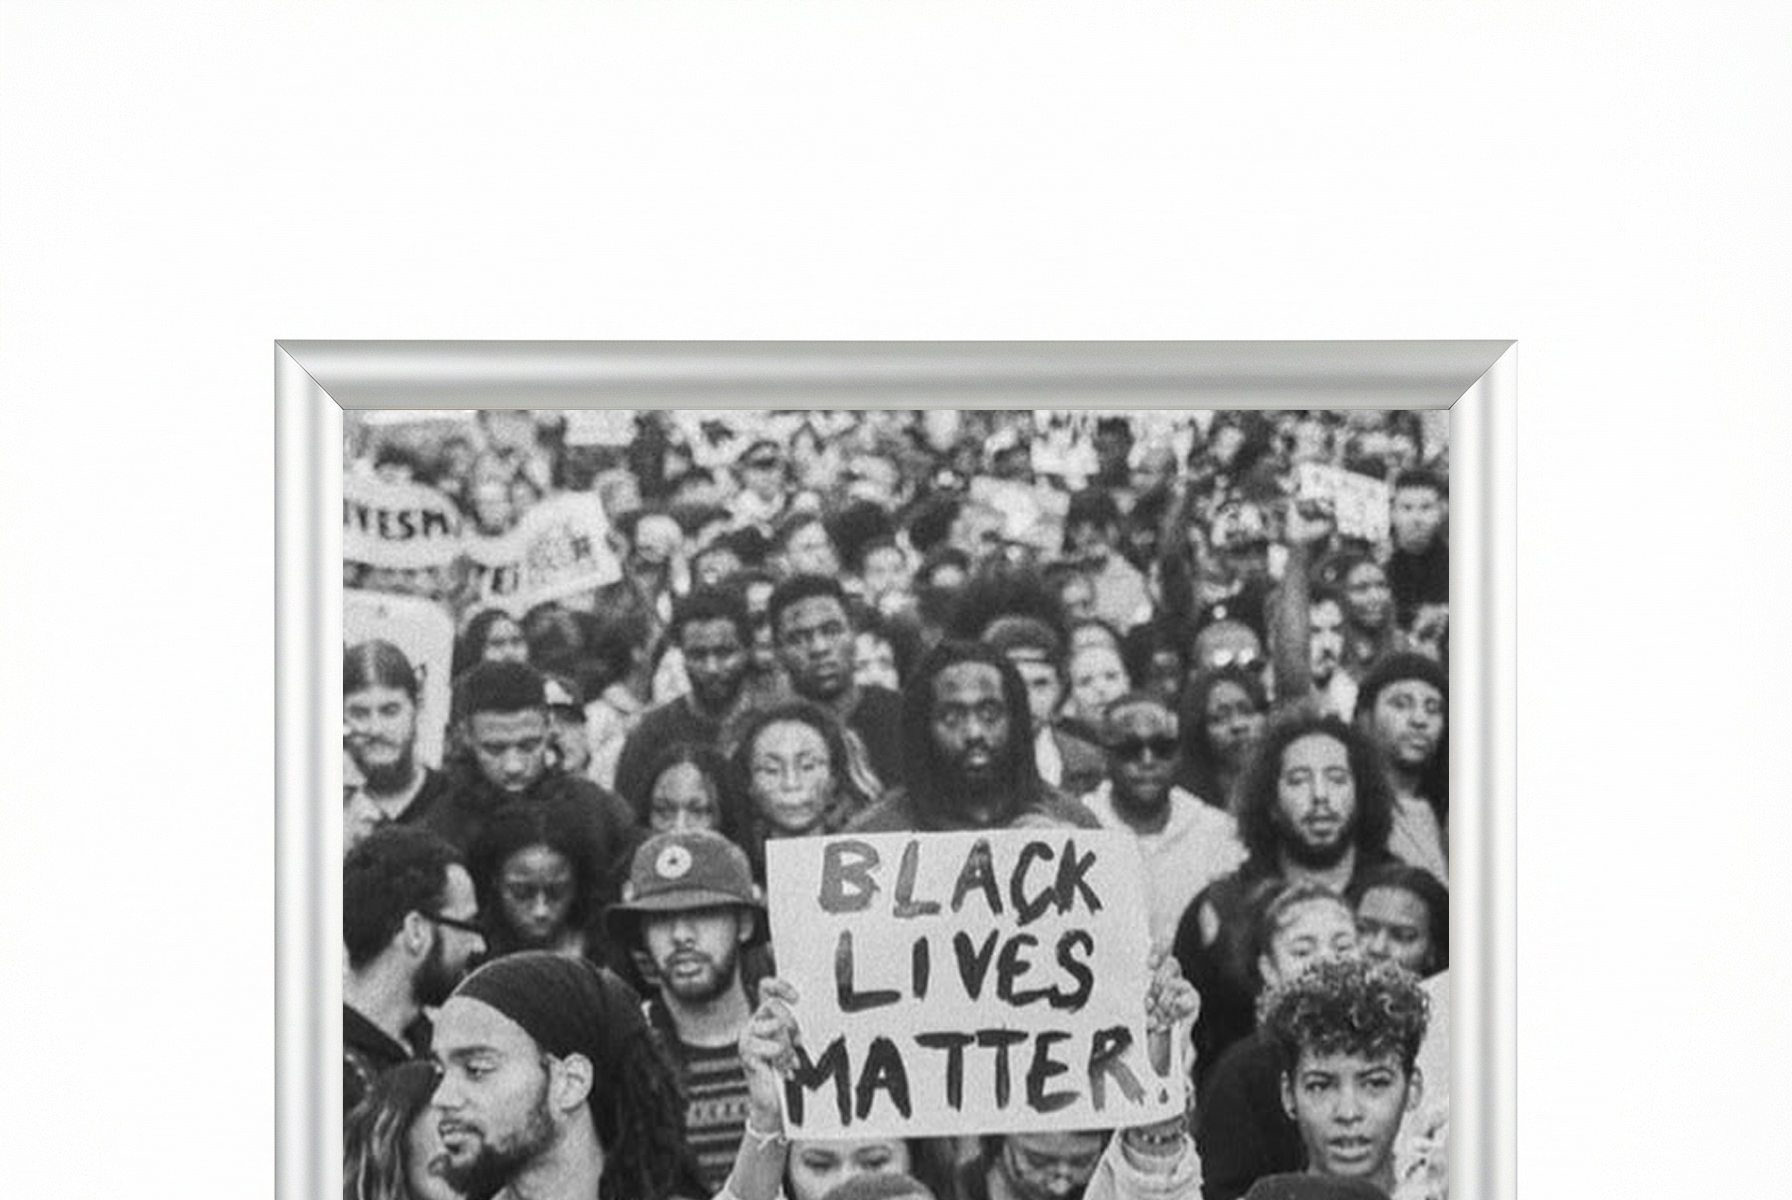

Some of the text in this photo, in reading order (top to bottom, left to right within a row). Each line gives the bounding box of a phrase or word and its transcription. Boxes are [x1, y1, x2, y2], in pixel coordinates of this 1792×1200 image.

[819, 838, 1103, 926] BLACK
[835, 928, 1094, 1014] LIVES
[784, 1025, 1172, 1127] MATTER!
